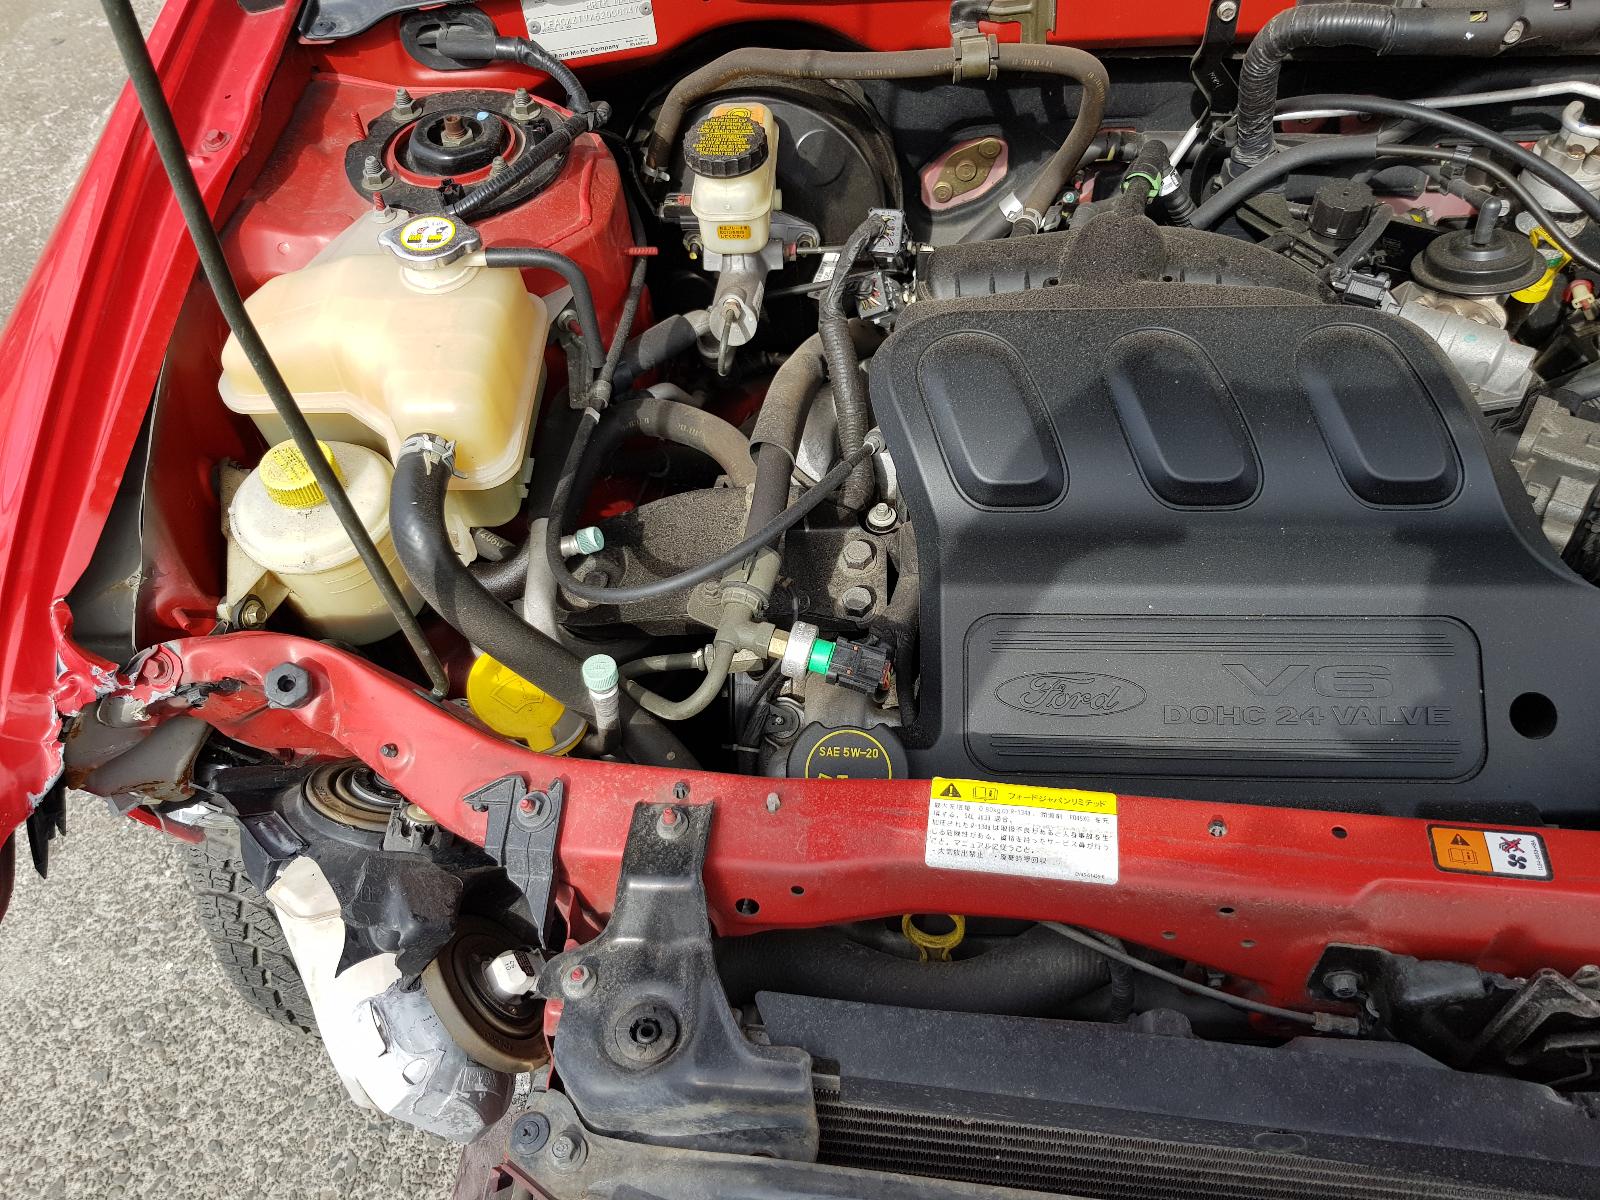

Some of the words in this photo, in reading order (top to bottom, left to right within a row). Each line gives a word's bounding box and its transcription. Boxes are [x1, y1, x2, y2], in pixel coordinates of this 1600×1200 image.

[590, 43, 619, 52] Company
[1221, 664, 1393, 699] V6
[1018, 674, 1119, 712] Ford
[1163, 705, 1266, 726] DOHC
[1275, 705, 1325, 726] 24
[1330, 705, 1453, 727] VALVE
[819, 746, 840, 757] SAE
[843, 747, 879, 759] 5W-20
